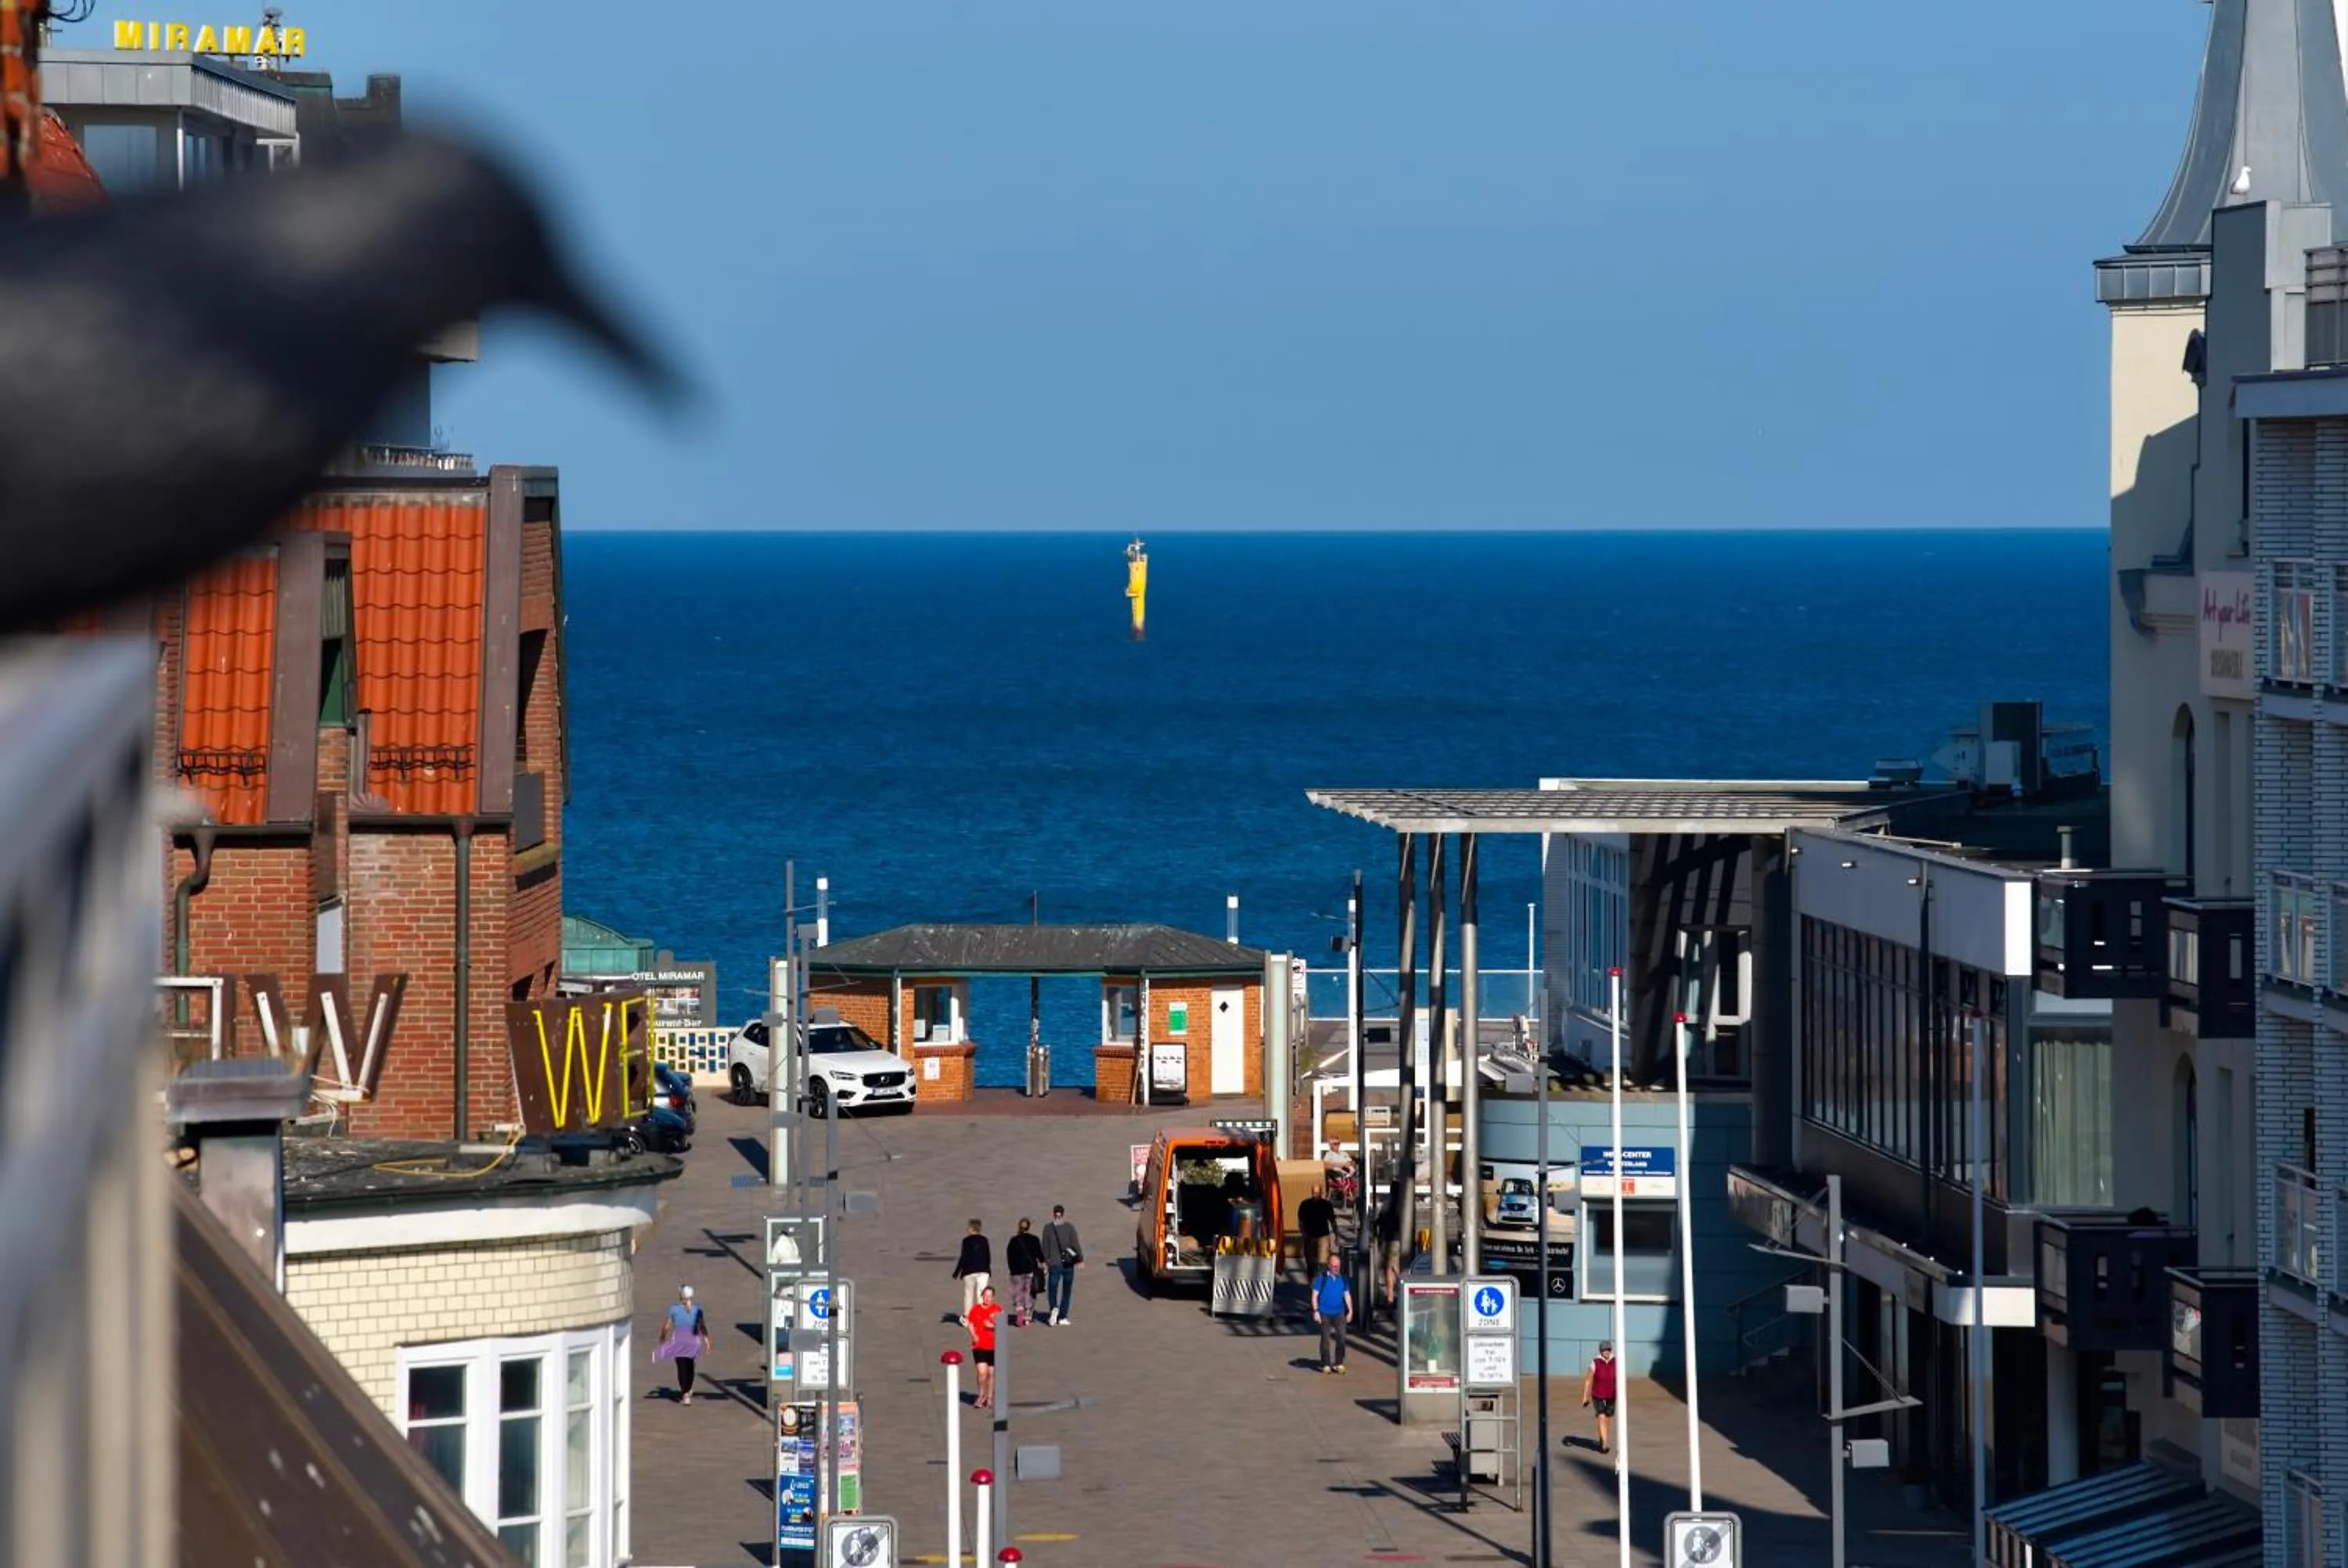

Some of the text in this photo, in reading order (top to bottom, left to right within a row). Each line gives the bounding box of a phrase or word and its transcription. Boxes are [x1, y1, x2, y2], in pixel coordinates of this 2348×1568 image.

[113, 20, 306, 57] MIRAMAR
[632, 971, 704, 980] OTEL MIRAMAR
